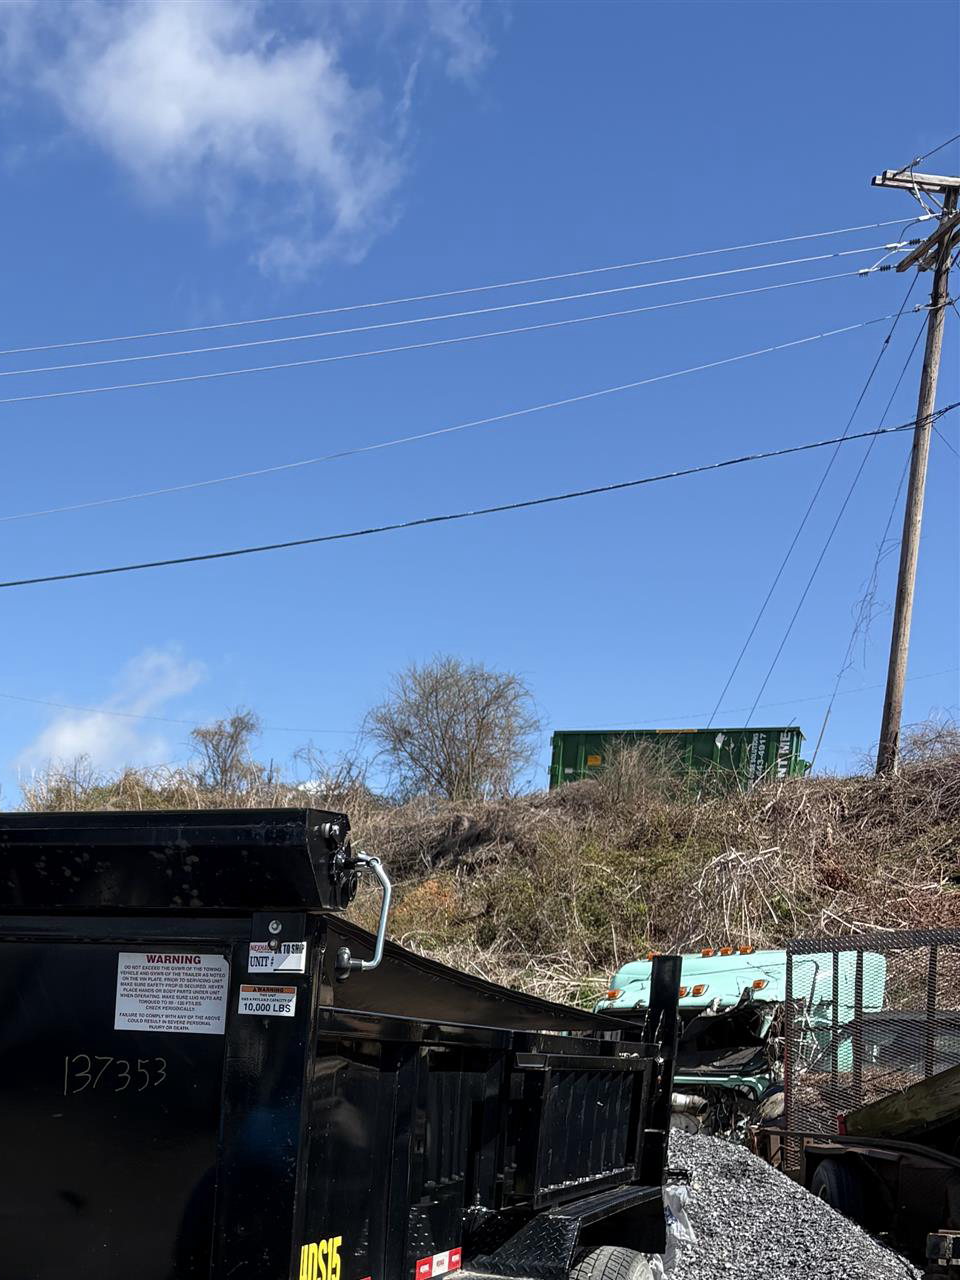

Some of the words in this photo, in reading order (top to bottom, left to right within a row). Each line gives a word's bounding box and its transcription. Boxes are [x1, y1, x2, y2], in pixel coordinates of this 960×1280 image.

[283, 944, 290, 954] TO
[146, 955, 201, 964] WARNING
[250, 956, 269, 967] UNIT
[244, 1003, 270, 1011] 10,000
[273, 1004, 291, 1012] LBS
[63, 1054, 167, 1096] 137353
